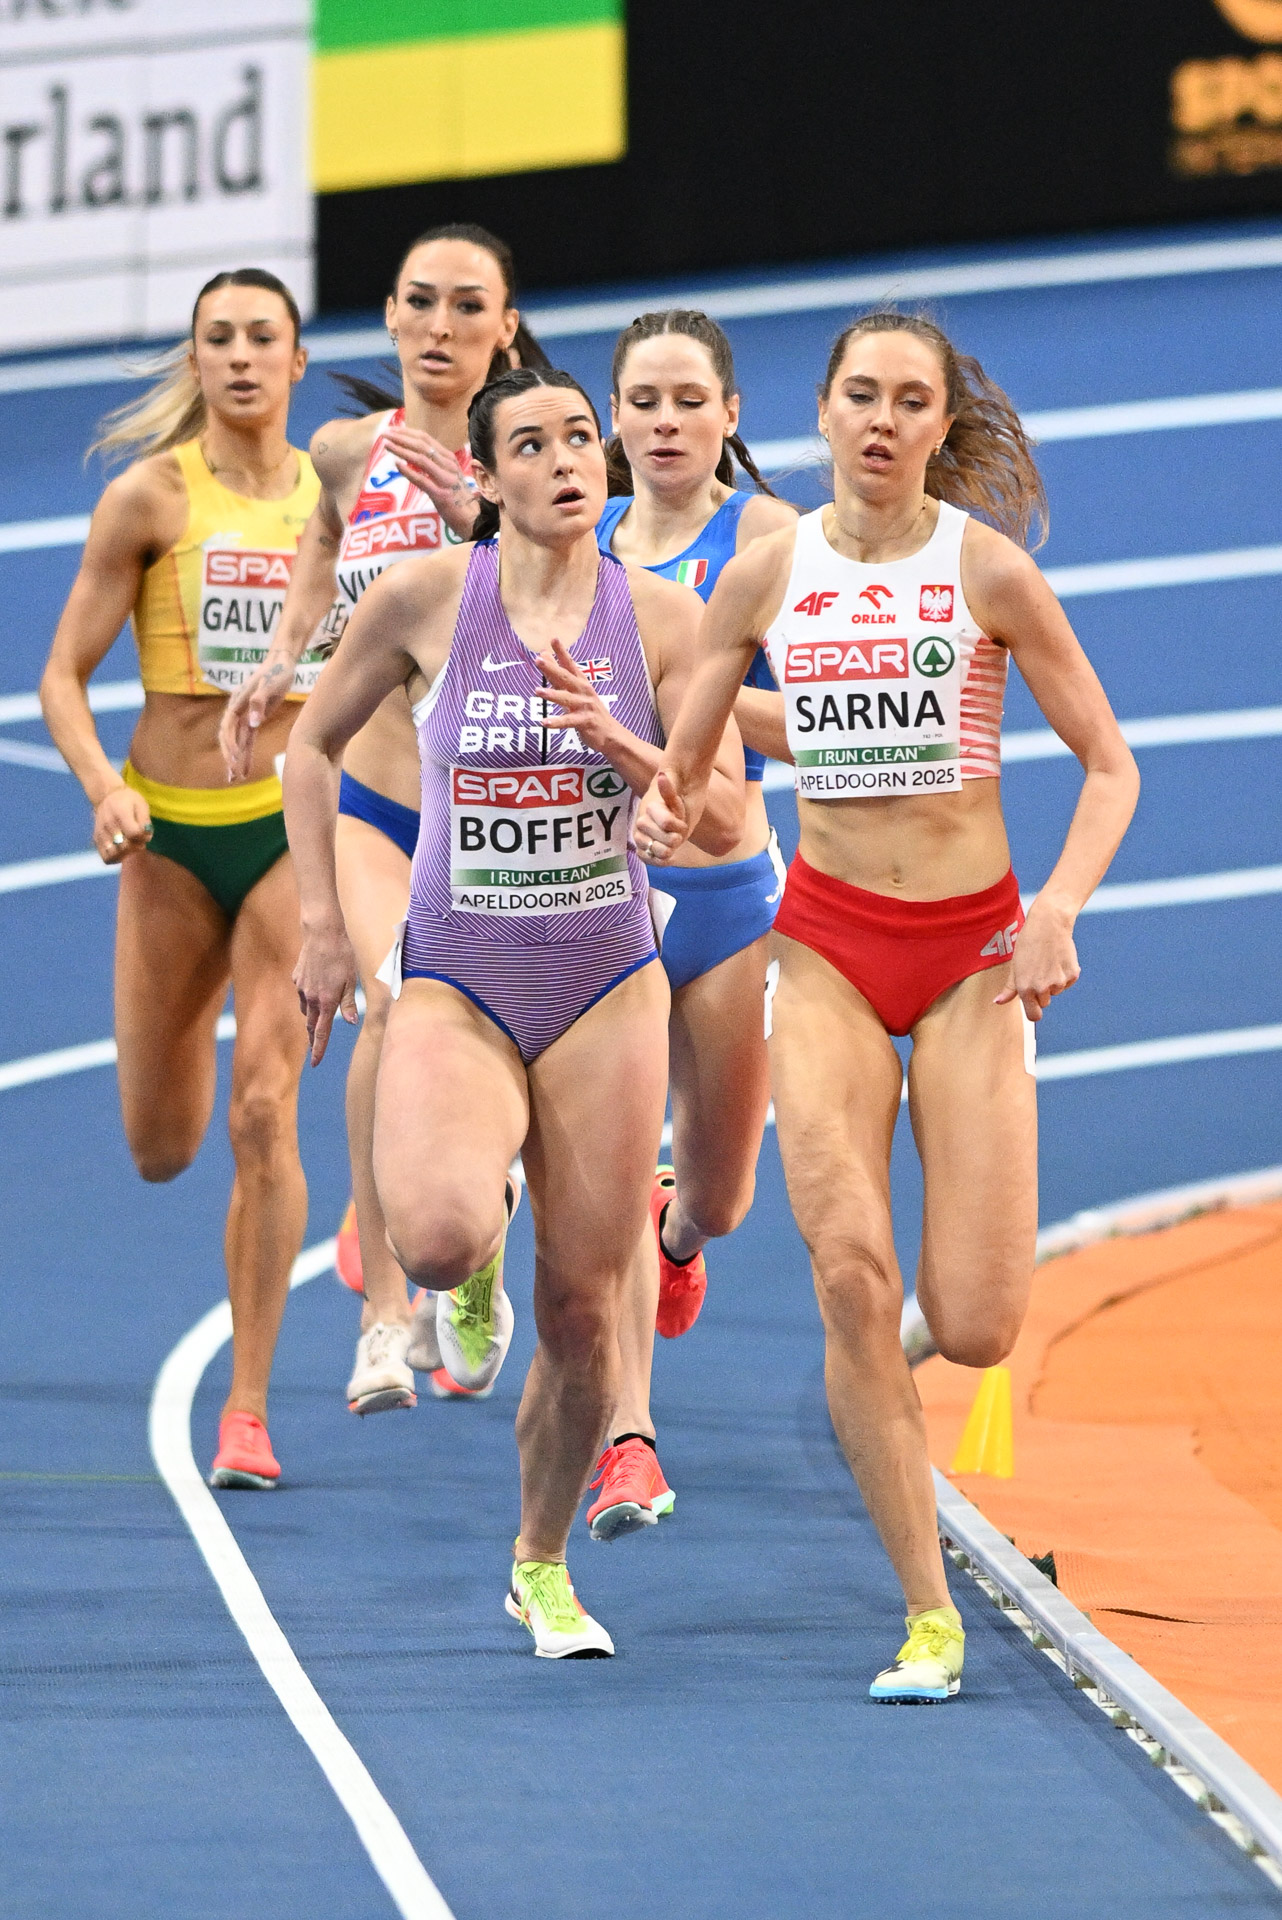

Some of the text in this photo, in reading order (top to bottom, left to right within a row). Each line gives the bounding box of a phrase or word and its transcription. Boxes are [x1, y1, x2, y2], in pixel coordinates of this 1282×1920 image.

[345, 518, 438, 559] SPAR
[210, 555, 291, 584] SPA
[793, 591, 839, 616] 4F
[851, 614, 896, 624] ORLEN
[787, 644, 906, 678] SPAR
[465, 691, 618, 724] GRET
[796, 690, 946, 733] SARNA
[459, 726, 600, 754] BRITA
[825, 750, 858, 764] RUN
[457, 772, 581, 804] SPAR
[801, 767, 956, 791] APELDOORN 2025
[460, 806, 621, 855] BOFFEY
[498, 871, 535, 885] RUN
[460, 880, 626, 910] APELDOORN 2025
[980, 920, 1019, 957] 4F
